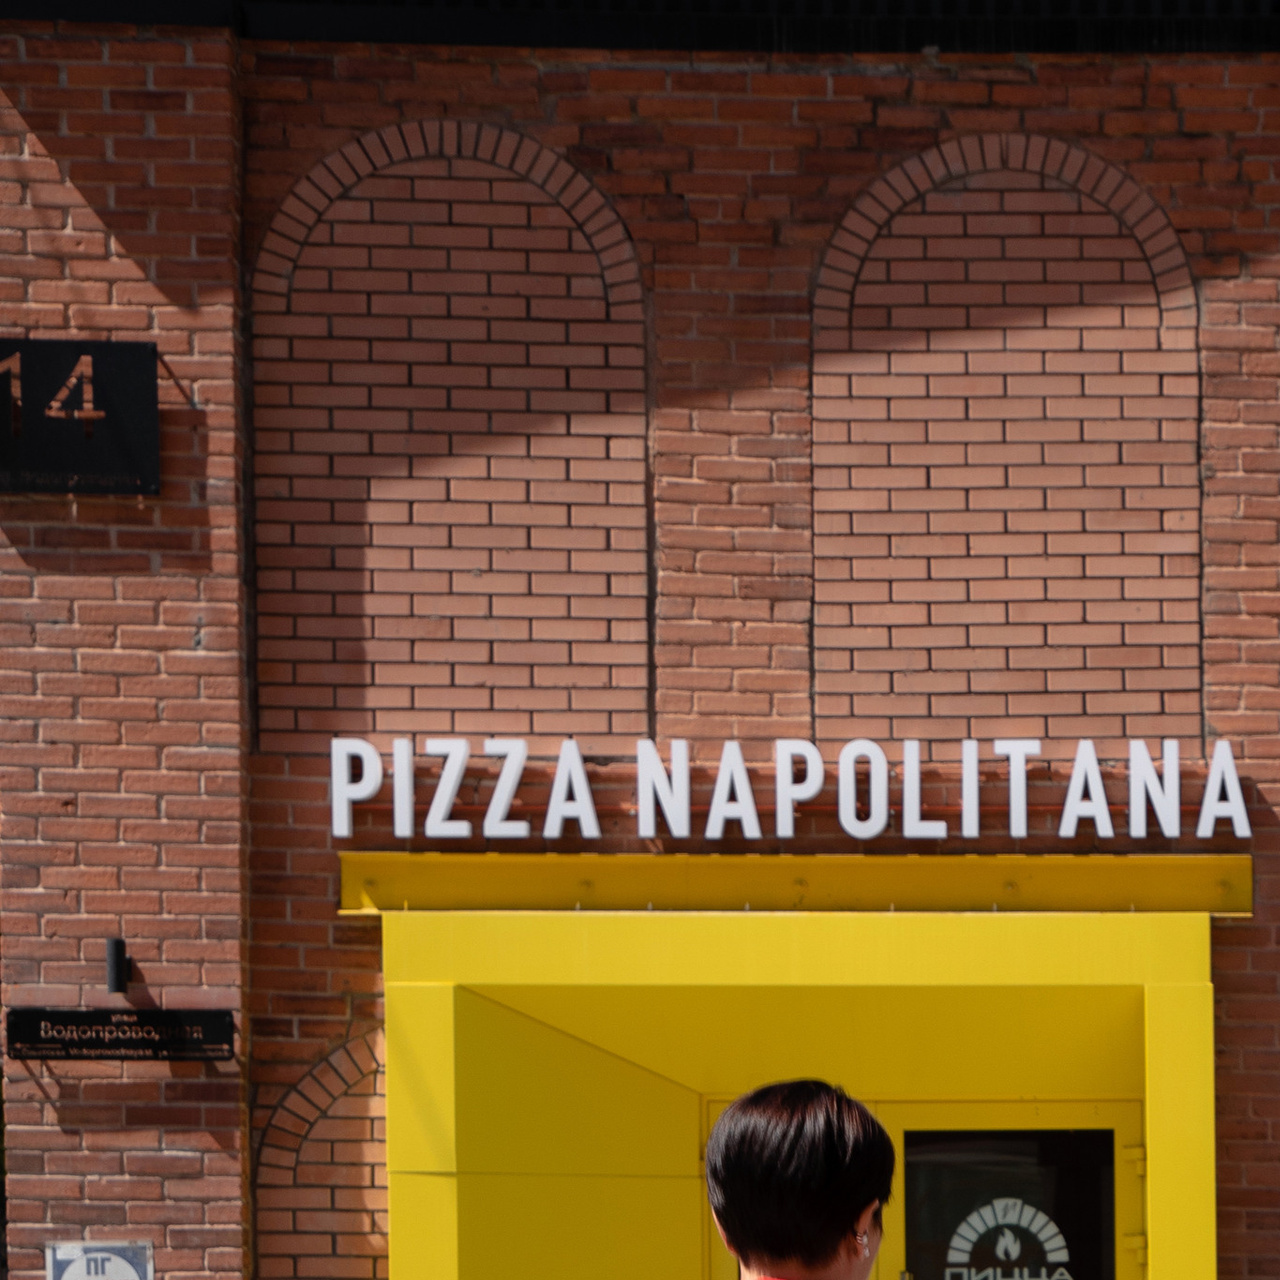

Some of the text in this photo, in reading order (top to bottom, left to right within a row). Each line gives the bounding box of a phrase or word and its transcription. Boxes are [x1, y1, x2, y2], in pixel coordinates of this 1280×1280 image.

[0, 352, 106, 439] 14
[330, 737, 1253, 840] PIZZA NAPOLITANA
[86, 1256, 112, 1276] ПГ
